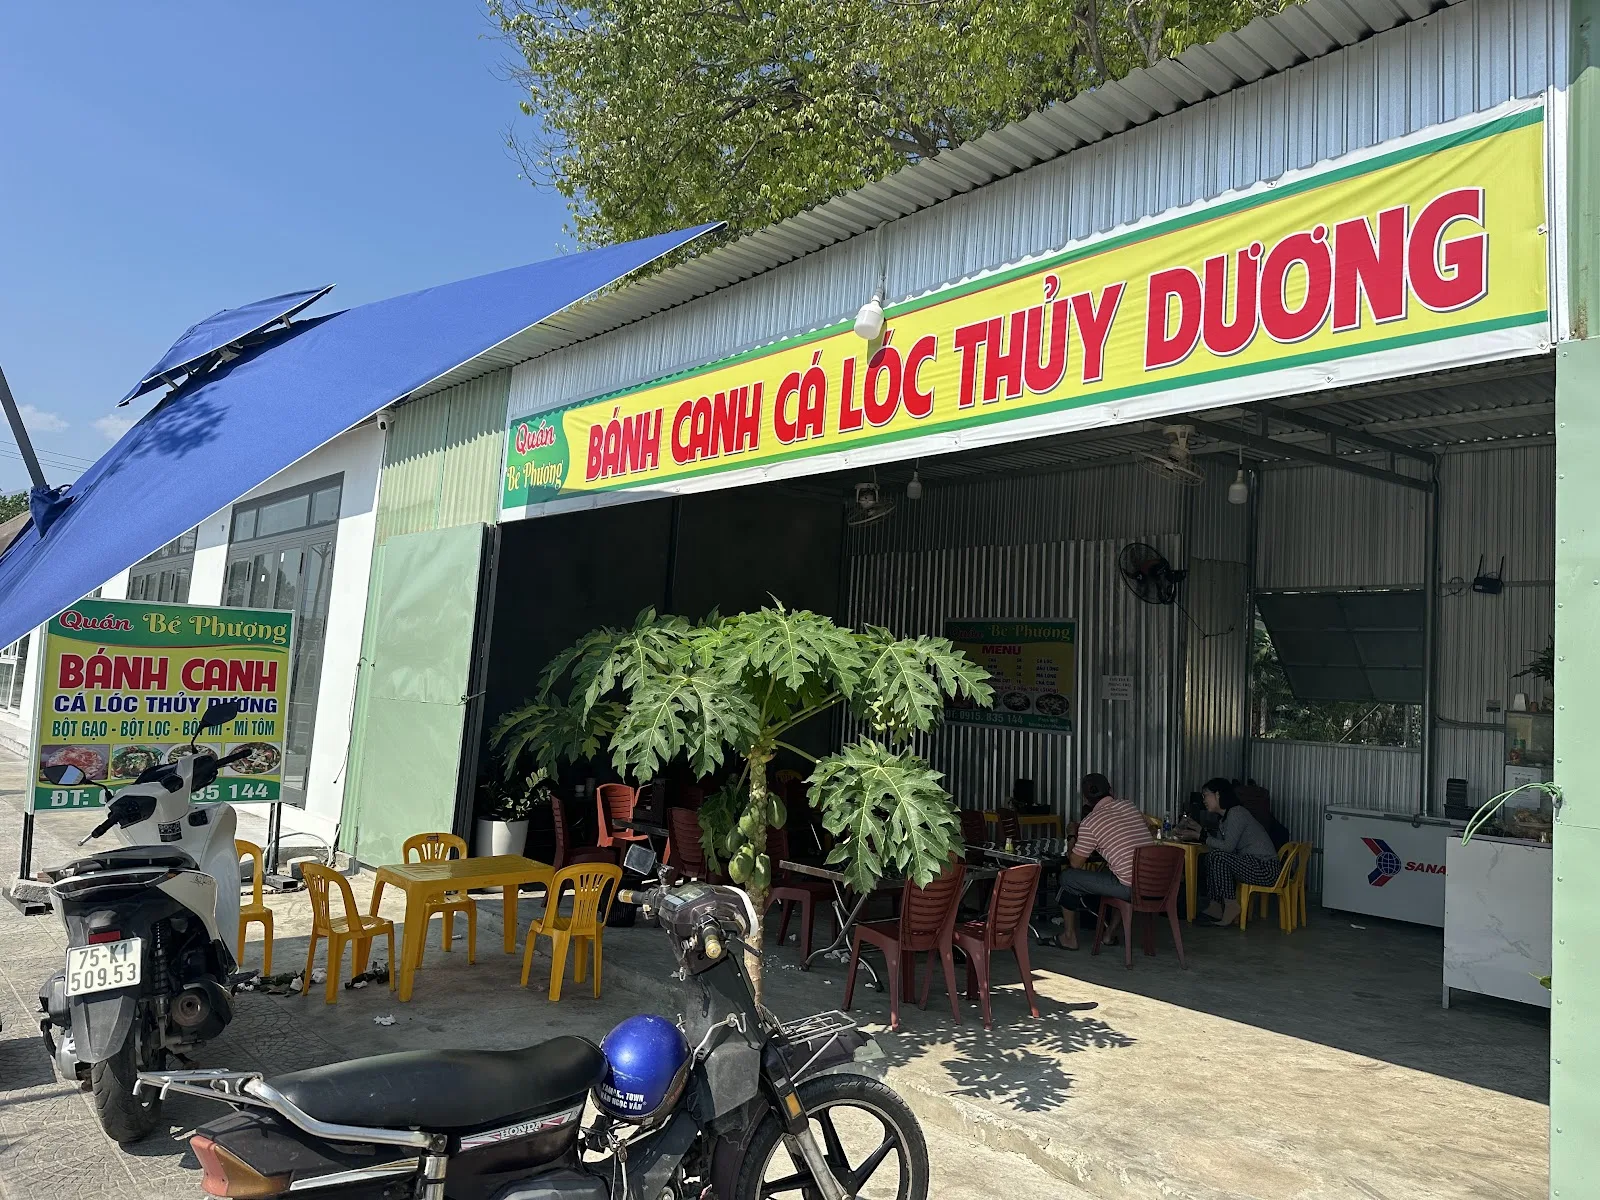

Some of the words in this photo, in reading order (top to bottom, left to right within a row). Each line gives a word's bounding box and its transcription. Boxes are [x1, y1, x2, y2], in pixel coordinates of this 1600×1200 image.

[584, 406, 664, 481] BÁNH
[670, 382, 765, 466] CANH
[773, 349, 828, 445] CÁ
[838, 328, 938, 434] LÓC
[953, 274, 1127, 409] THỦY
[1144, 186, 1490, 373] DƯƠNG
[515, 419, 557, 456] Quán
[506, 465, 521, 492] Bé
[523, 459, 564, 490] Phượng
[59, 610, 134, 632] Quán
[142, 612, 182, 635] Bé
[188, 615, 287, 645] Phượng
[981, 645, 1023, 655] MENU
[58, 647, 169, 691] BÁNH
[181, 657, 279, 693] CANH
[54, 692, 86, 713] CÁ
[94, 692, 139, 714] LÓC
[145, 691, 202, 714] THỦY
[52, 718, 78, 740] BỘT
[81, 719, 108, 740] GẠO
[120, 718, 145, 740] BỘT
[147, 720, 171, 740] LỌC
[251, 717, 275, 736] TÔM
[1007, 714, 1023, 724] 144
[50, 789, 90, 807] ĐT:
[191, 784, 220, 801] 35
[228, 782, 269, 800] 144
[79, 942, 128, 969] 75-K1
[71, 962, 137, 992] 509.53
[625, 1092, 645, 1102] TOWN
[500, 1120, 542, 1140] HONDA
